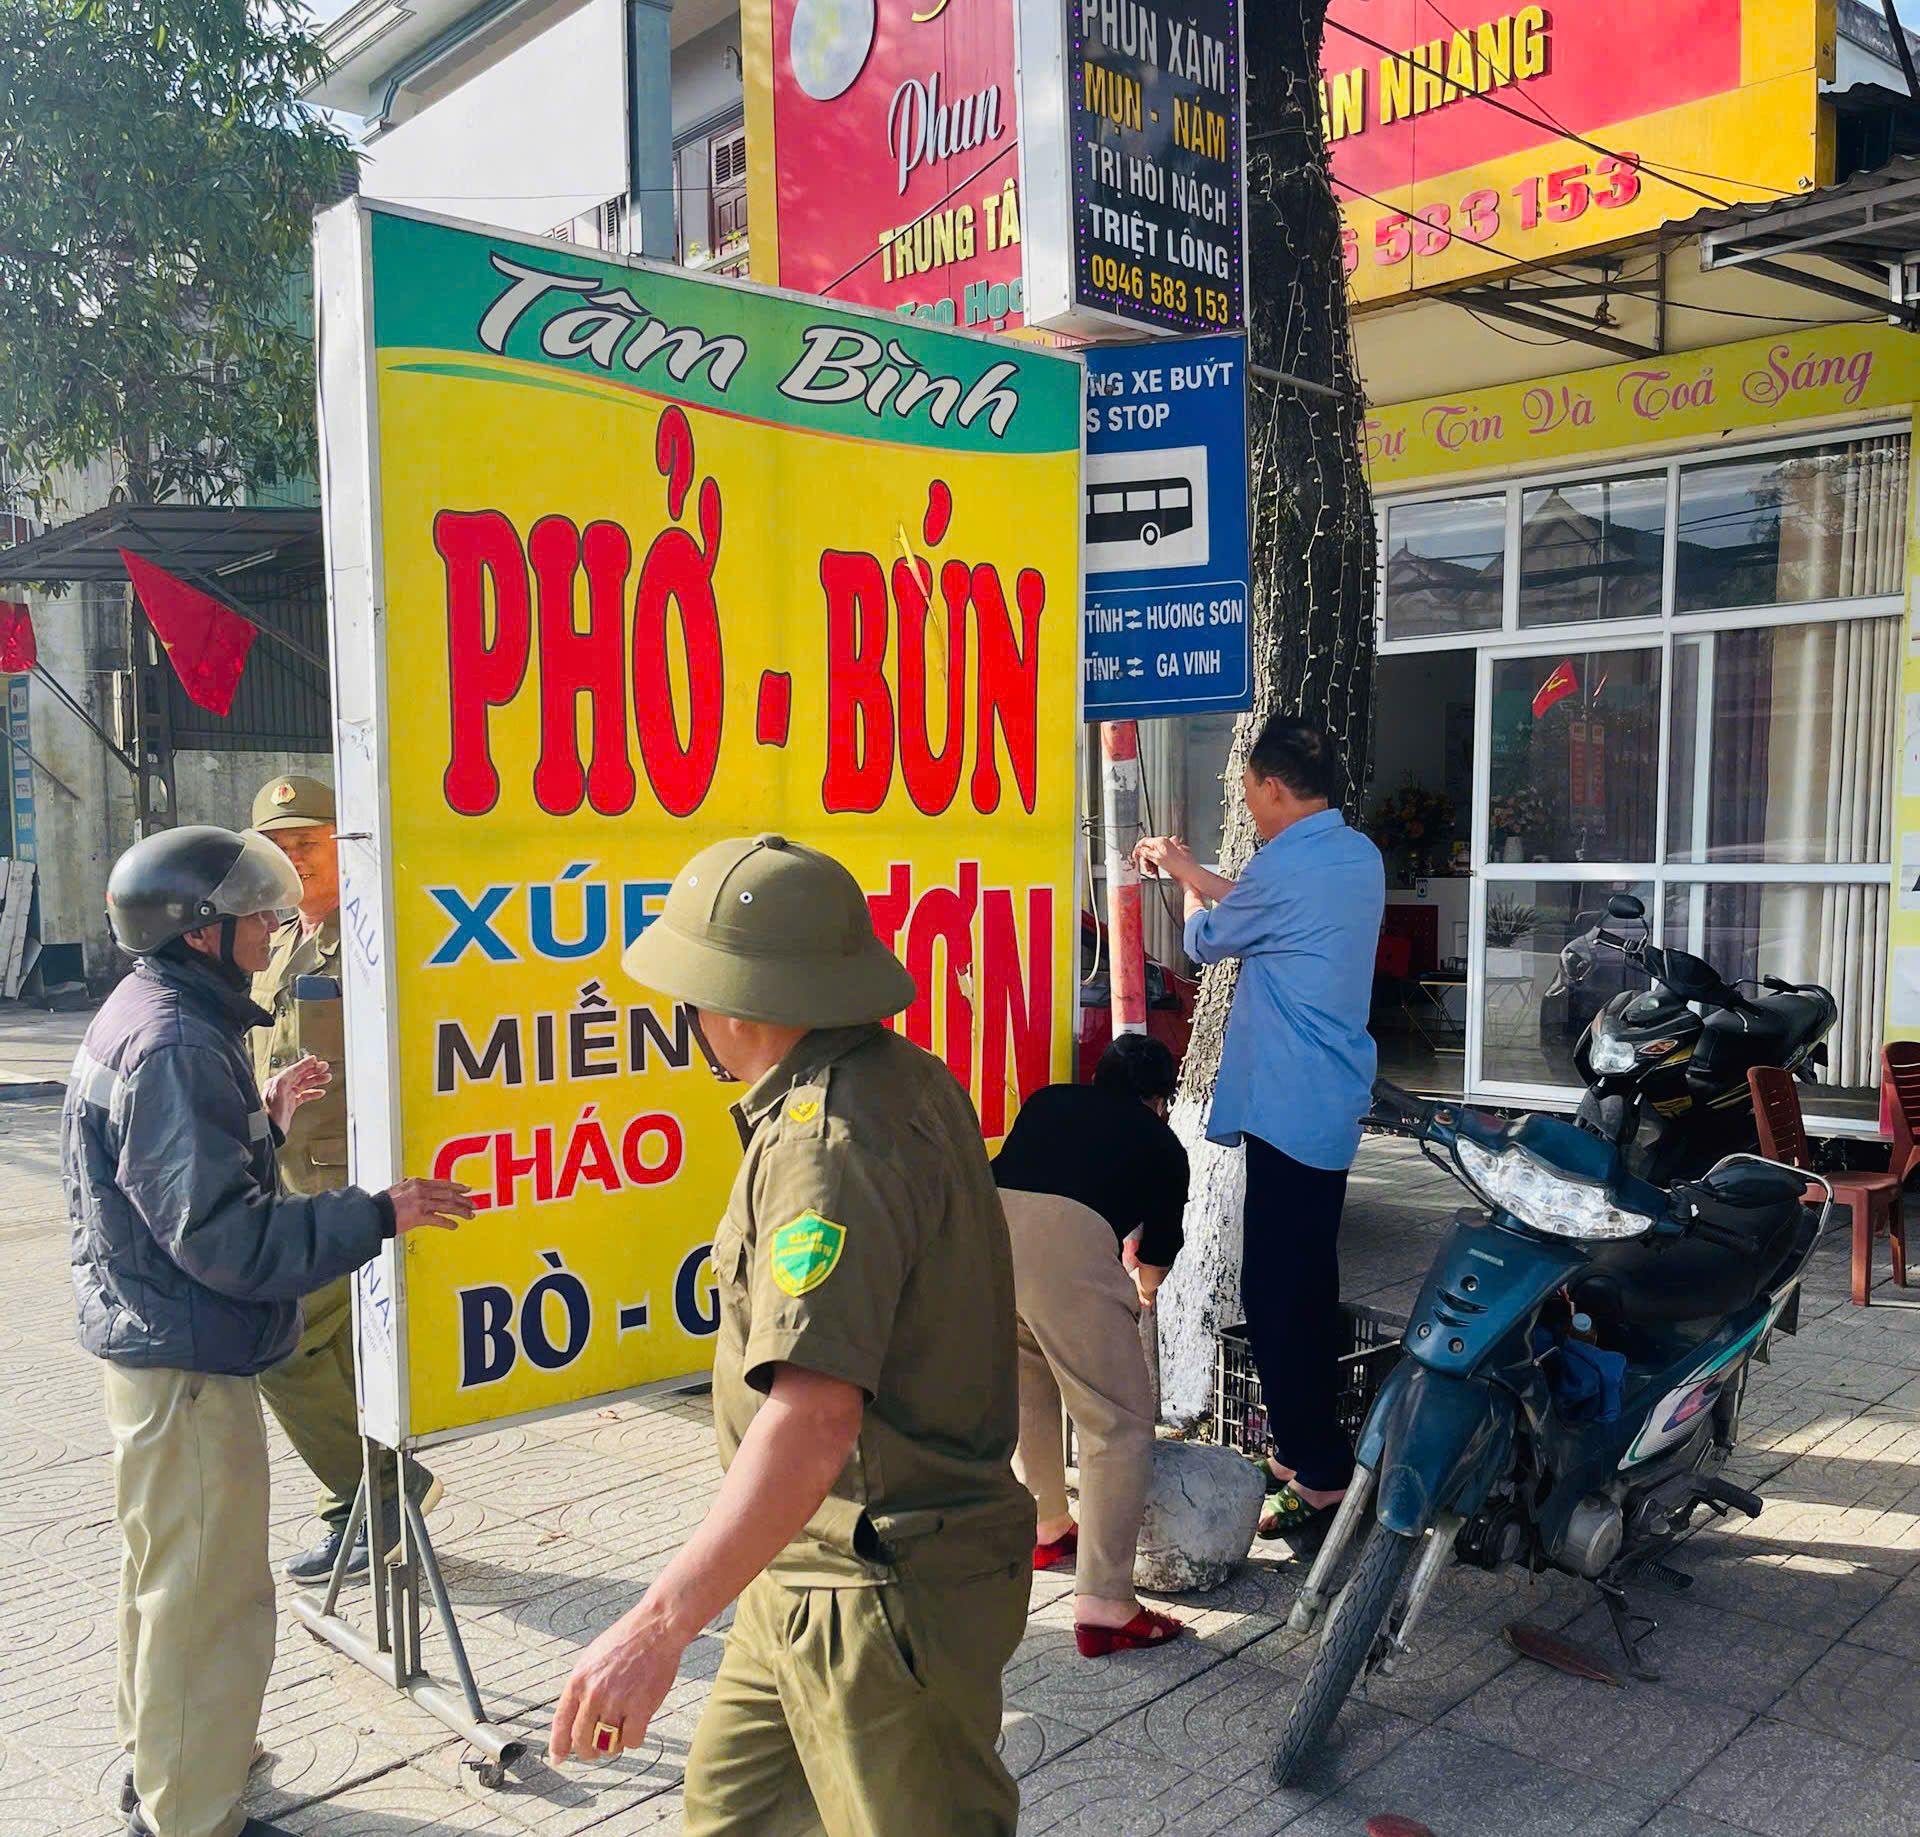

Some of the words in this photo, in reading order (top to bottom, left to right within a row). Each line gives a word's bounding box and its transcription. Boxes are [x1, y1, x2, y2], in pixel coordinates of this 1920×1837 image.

[1081, 0, 1158, 67] PHUN
[1168, 15, 1226, 95] XĂM
[1380, 5, 1547, 126] NHANG
[888, 71, 1004, 196] Phun
[1084, 61, 1143, 135] MỤN
[1173, 96, 1226, 163] NÁM
[1087, 141, 1122, 198] TRỊ
[1129, 155, 1164, 204] HÔI
[1172, 171, 1226, 226] NÁCH
[1374, 189, 1500, 266] 583
[1512, 152, 1640, 230] 153
[878, 204, 975, 283] TRUNG
[1089, 203, 1158, 260] TRIỆT
[1167, 227, 1229, 280] LÔNG
[1092, 254, 1143, 300] 0946
[1150, 272, 1187, 313] 583
[1194, 285, 1228, 325] 153
[478, 250, 748, 393] Tâm
[777, 325, 1020, 438] Bình
[1087, 371, 1124, 398] NG
[1131, 369, 1163, 395] XE
[1170, 357, 1234, 391] BUÝT
[1108, 403, 1170, 432] STOP
[1421, 405, 1504, 452] Tin
[1521, 386, 1595, 435] Và
[1616, 367, 1717, 421] Toả
[1742, 343, 1873, 408] Sáng
[433, 404, 724, 818] PHỞ
[819, 479, 1046, 816] BÚN
[1086, 603, 1124, 634] TĨNH
[1146, 602, 1205, 631] HƯƠNG
[1209, 598, 1243, 626] SƠN
[1085, 651, 1121, 682] TĨNH
[1156, 653, 1180, 678] GA
[1183, 650, 1221, 676] VINH
[437, 980, 690, 1092] MIẾN
[867, 861, 1053, 1139] ƠN
[433, 1105, 683, 1212] CHÁO
[459, 1250, 591, 1388] BÒ
